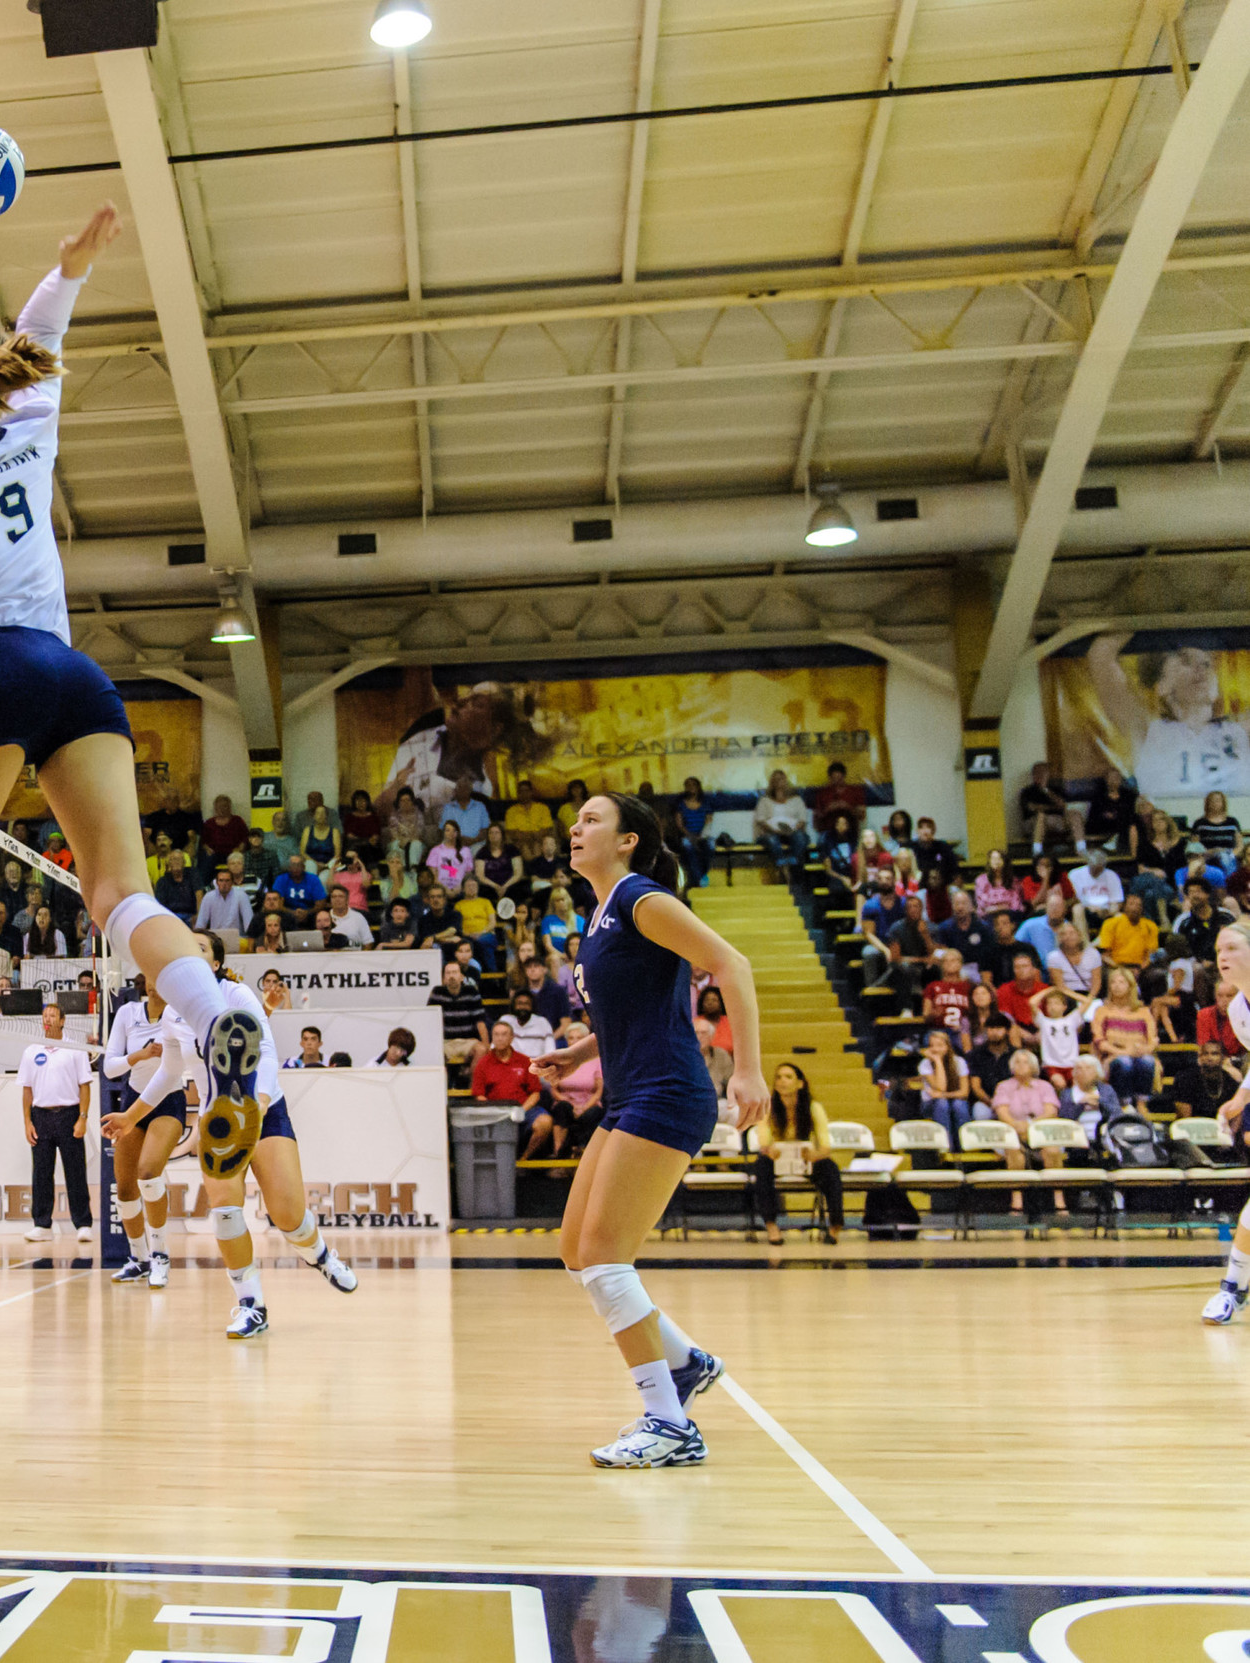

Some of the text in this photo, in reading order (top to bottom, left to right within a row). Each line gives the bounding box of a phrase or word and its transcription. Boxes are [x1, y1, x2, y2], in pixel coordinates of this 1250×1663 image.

[257, 971, 430, 991] GTATHLETICS
[944, 1006, 961, 1026] 2
[245, 1182, 418, 1219] ECH
[265, 1213, 440, 1228] LEYBALL
